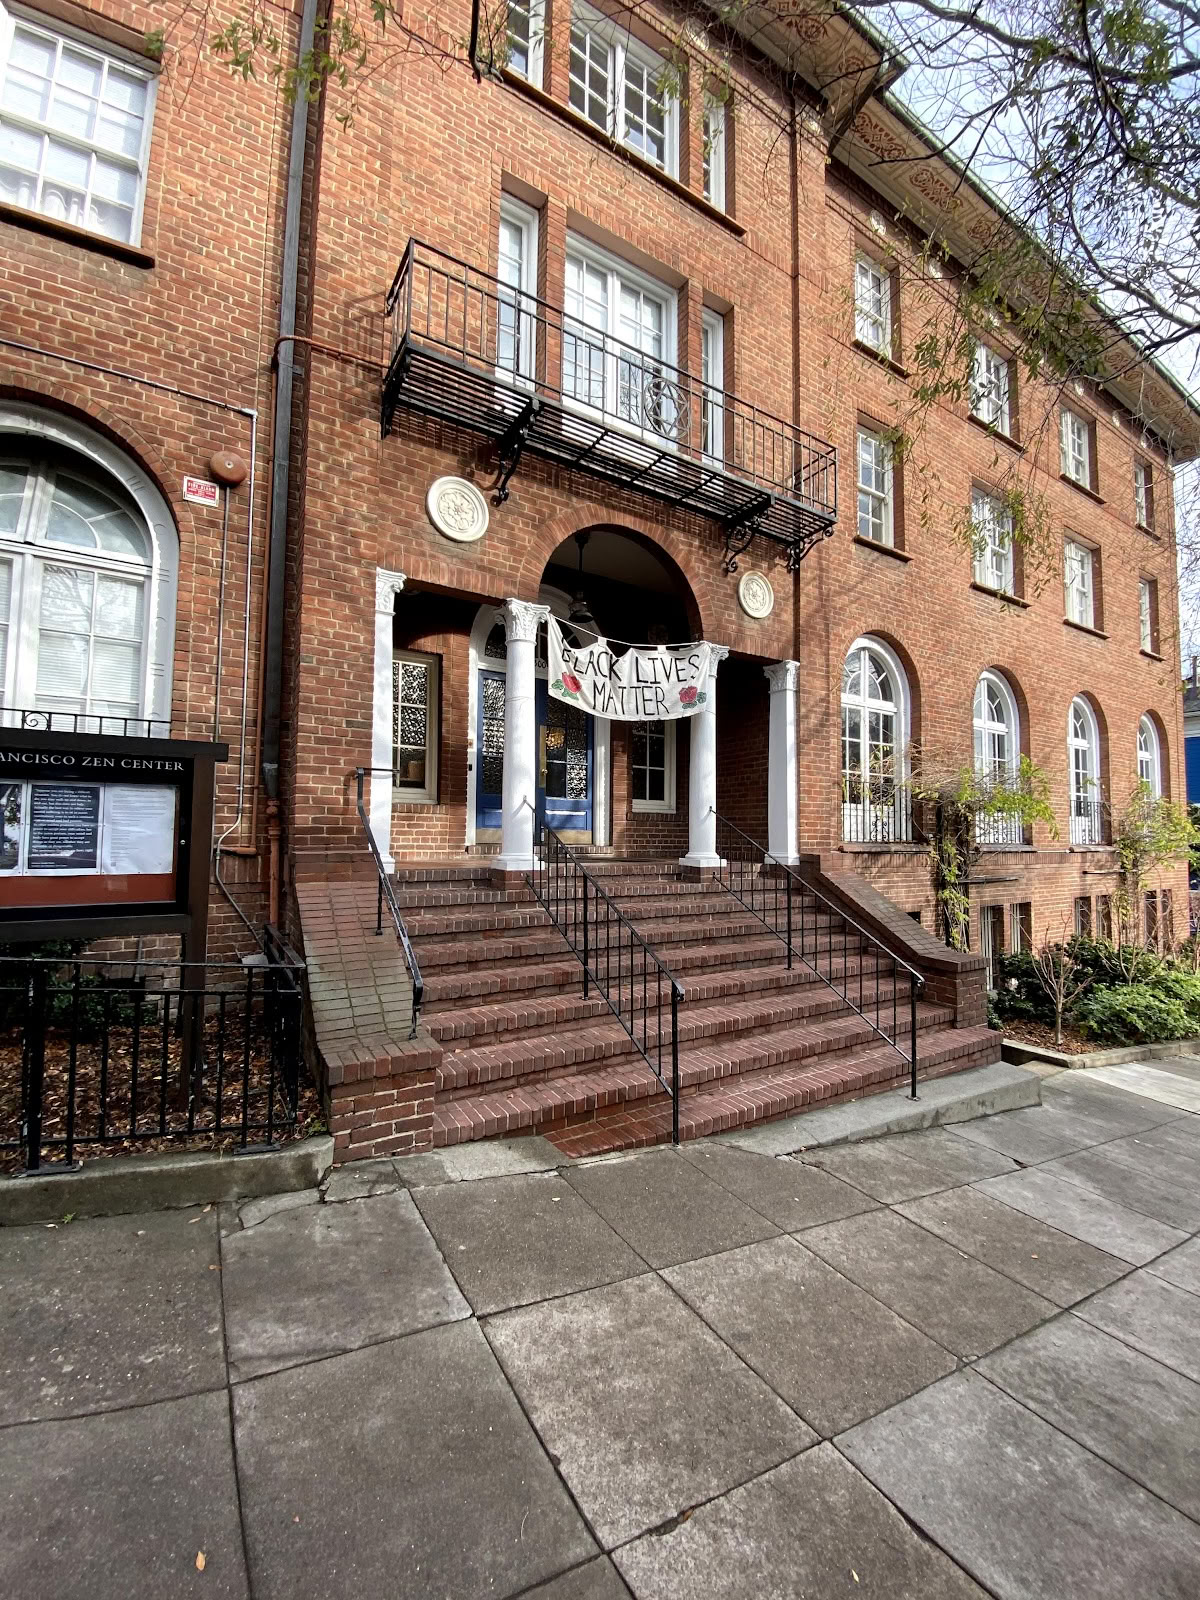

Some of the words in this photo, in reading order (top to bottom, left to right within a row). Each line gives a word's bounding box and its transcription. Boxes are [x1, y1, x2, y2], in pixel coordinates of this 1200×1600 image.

[562, 638, 622, 682] BLACK
[635, 654, 700, 684] LIVES
[592, 680, 670, 715] MATTER
[81, 756, 116, 767] ZEN
[120, 758, 185, 771] CENTER
